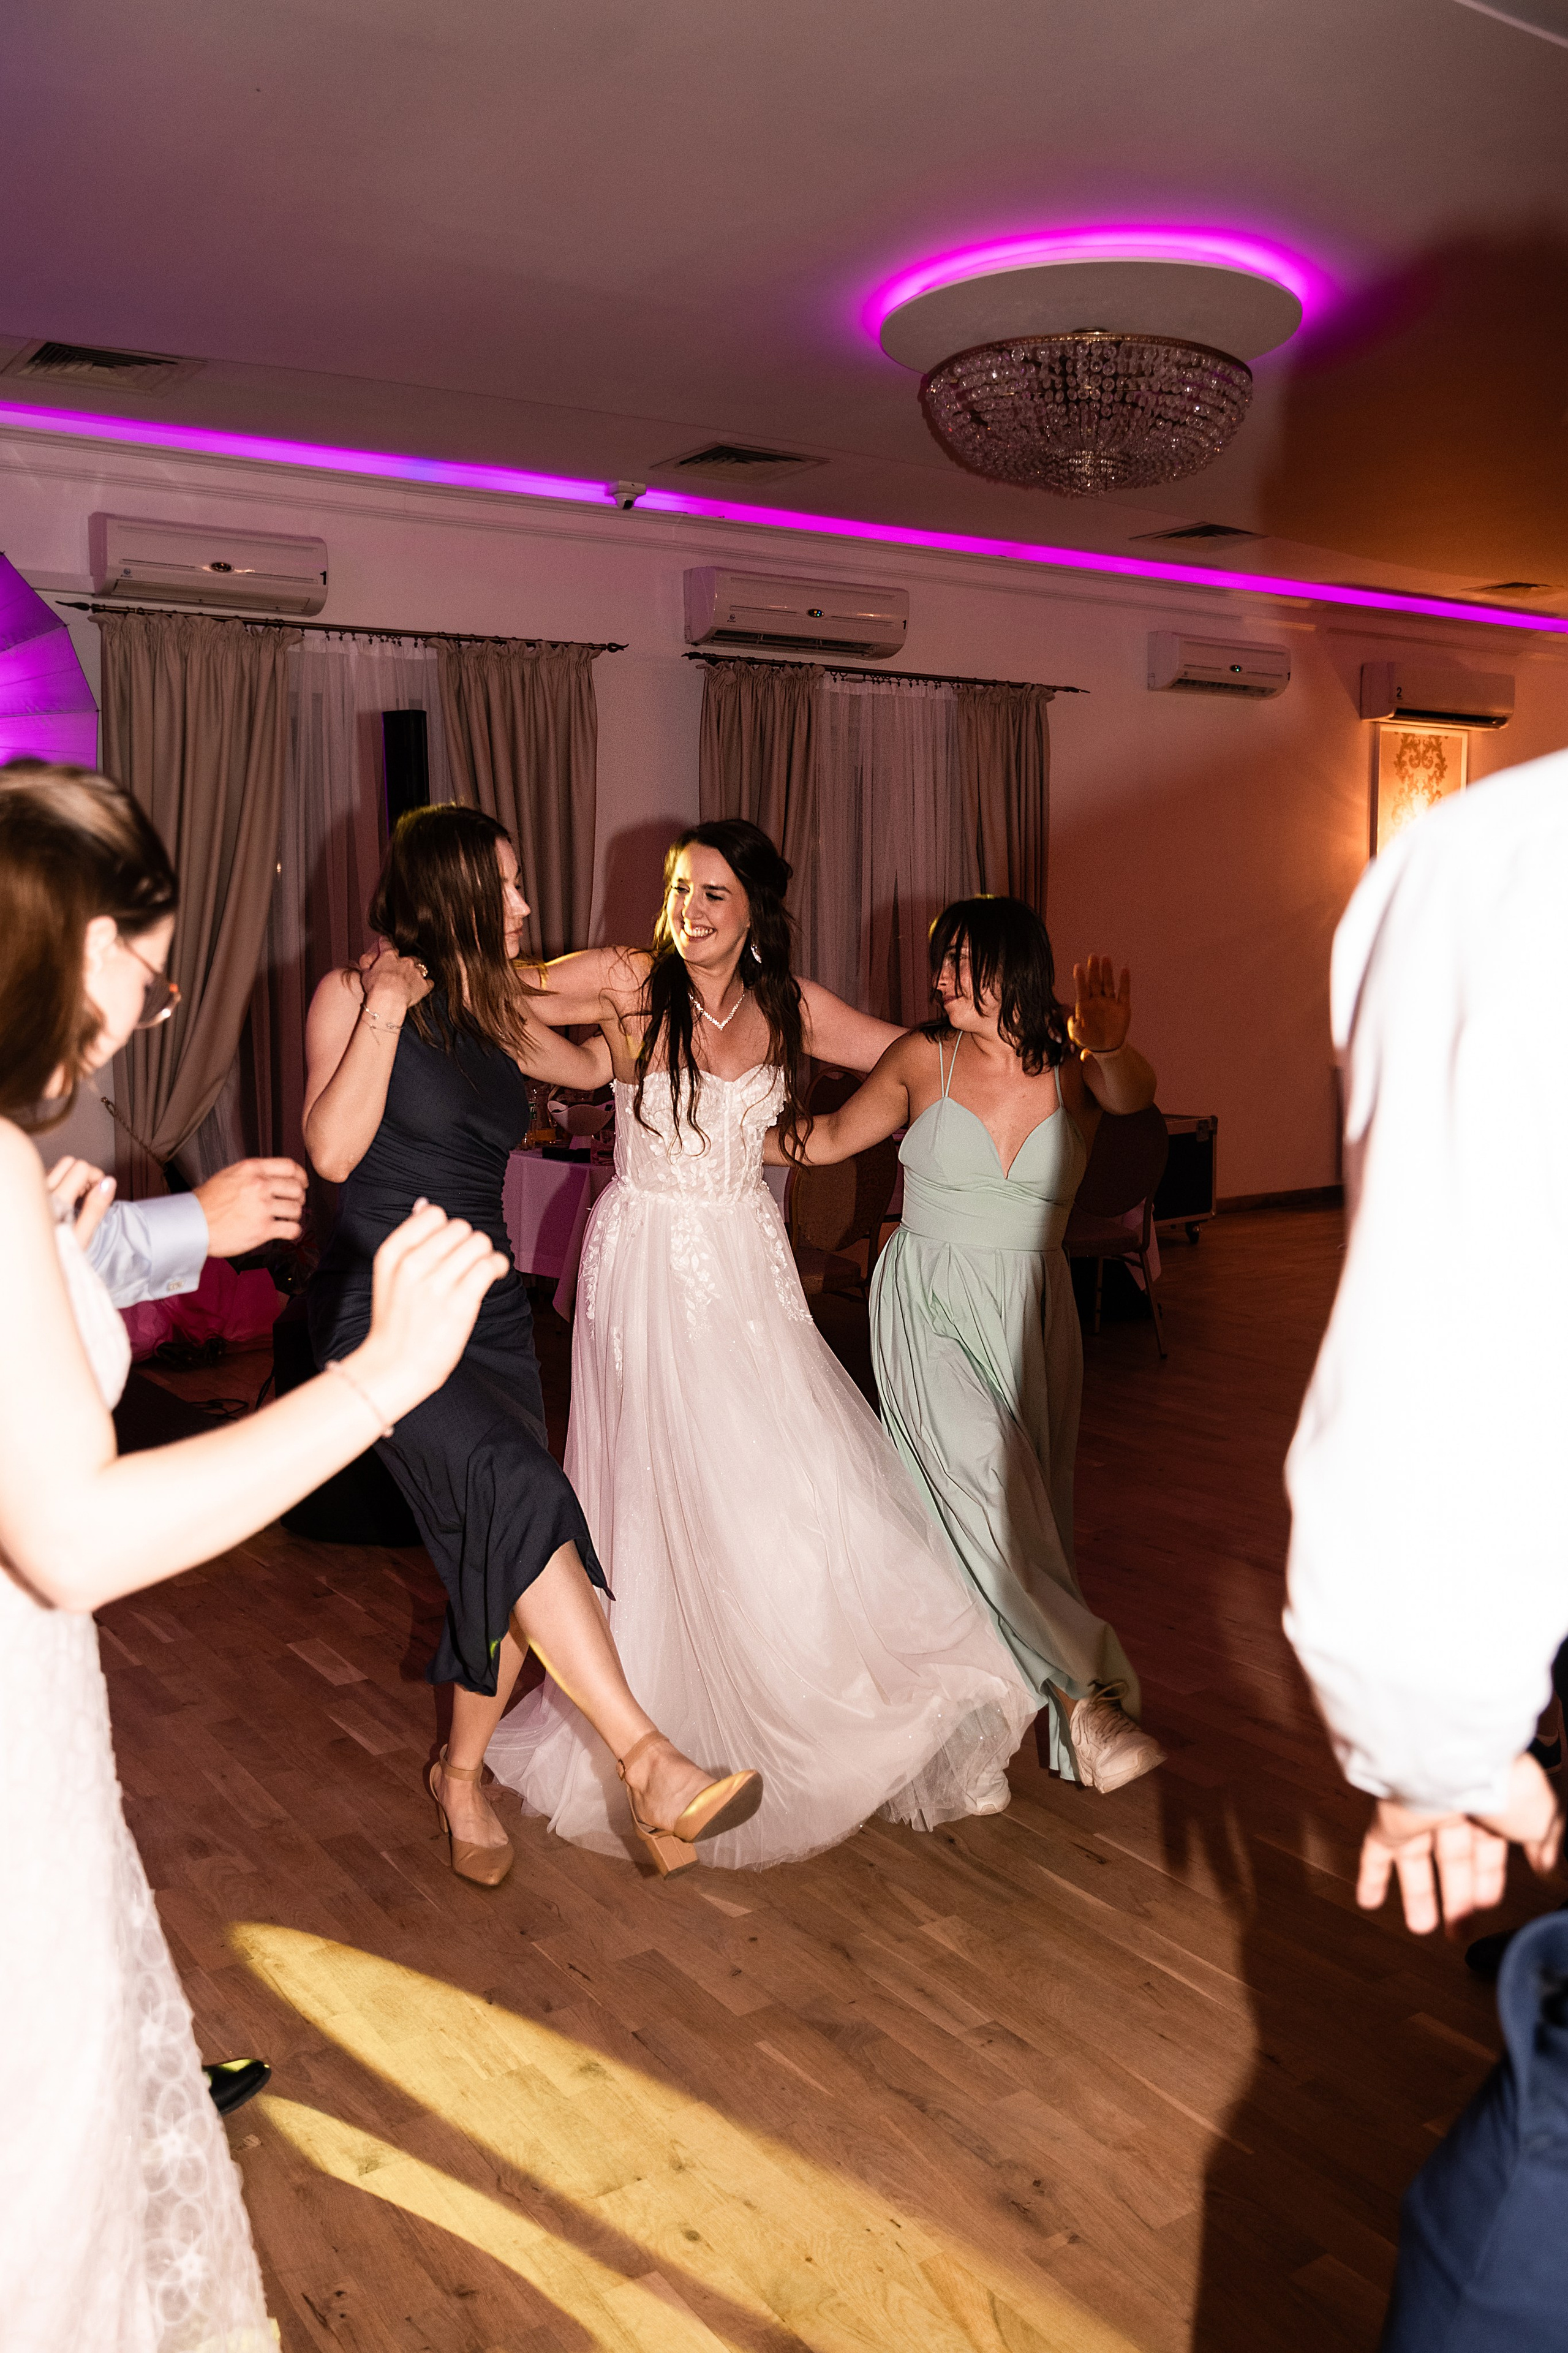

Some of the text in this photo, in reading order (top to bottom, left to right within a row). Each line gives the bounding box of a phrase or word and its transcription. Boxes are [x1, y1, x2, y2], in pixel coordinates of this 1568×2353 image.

[320, 570, 327, 586] 1
[902, 619, 907, 630] 1
[1396, 687, 1403, 697] 2
